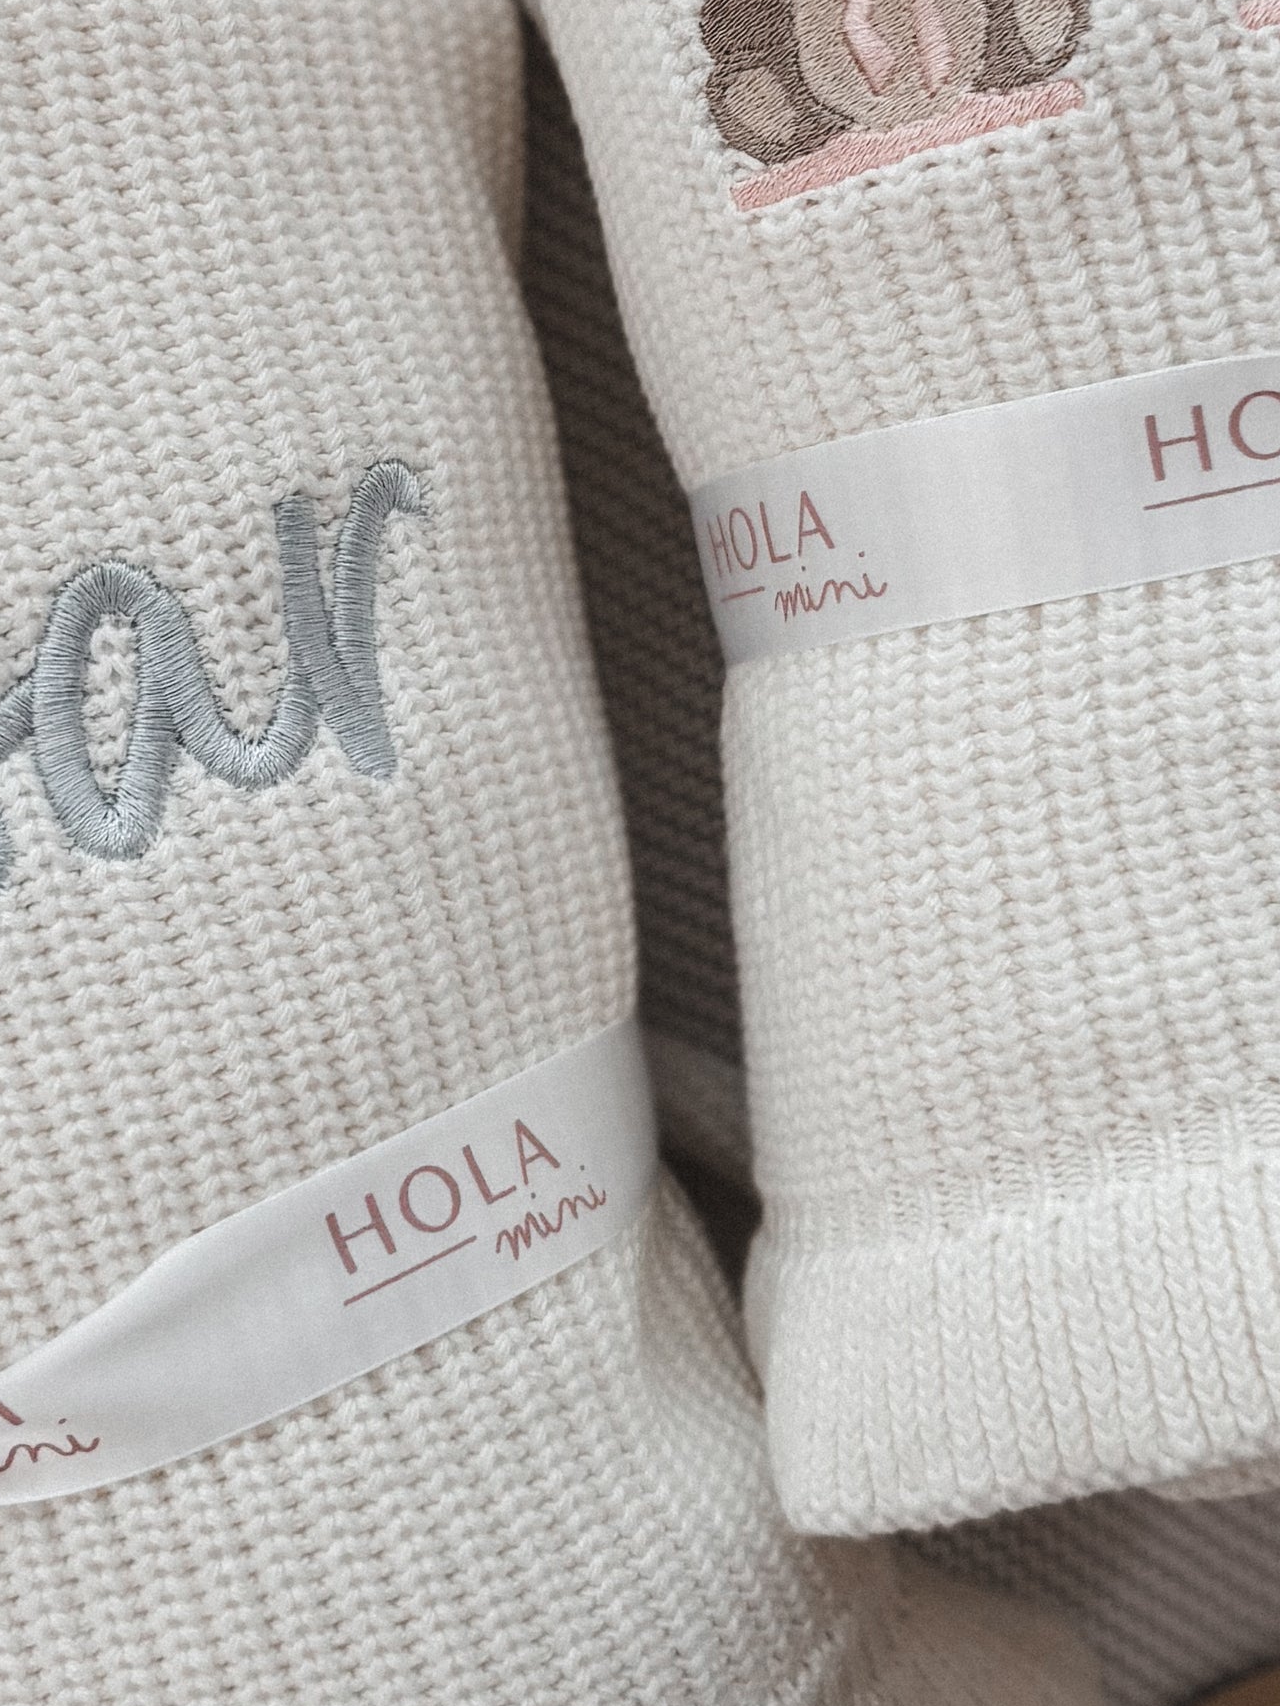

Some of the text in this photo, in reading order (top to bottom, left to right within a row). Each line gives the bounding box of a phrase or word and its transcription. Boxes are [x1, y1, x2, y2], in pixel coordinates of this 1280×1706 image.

[706, 490, 835, 579] HOLA
[774, 550, 888, 623] mini
[324, 1118, 561, 1275] HOLA
[495, 1163, 607, 1261] mini
